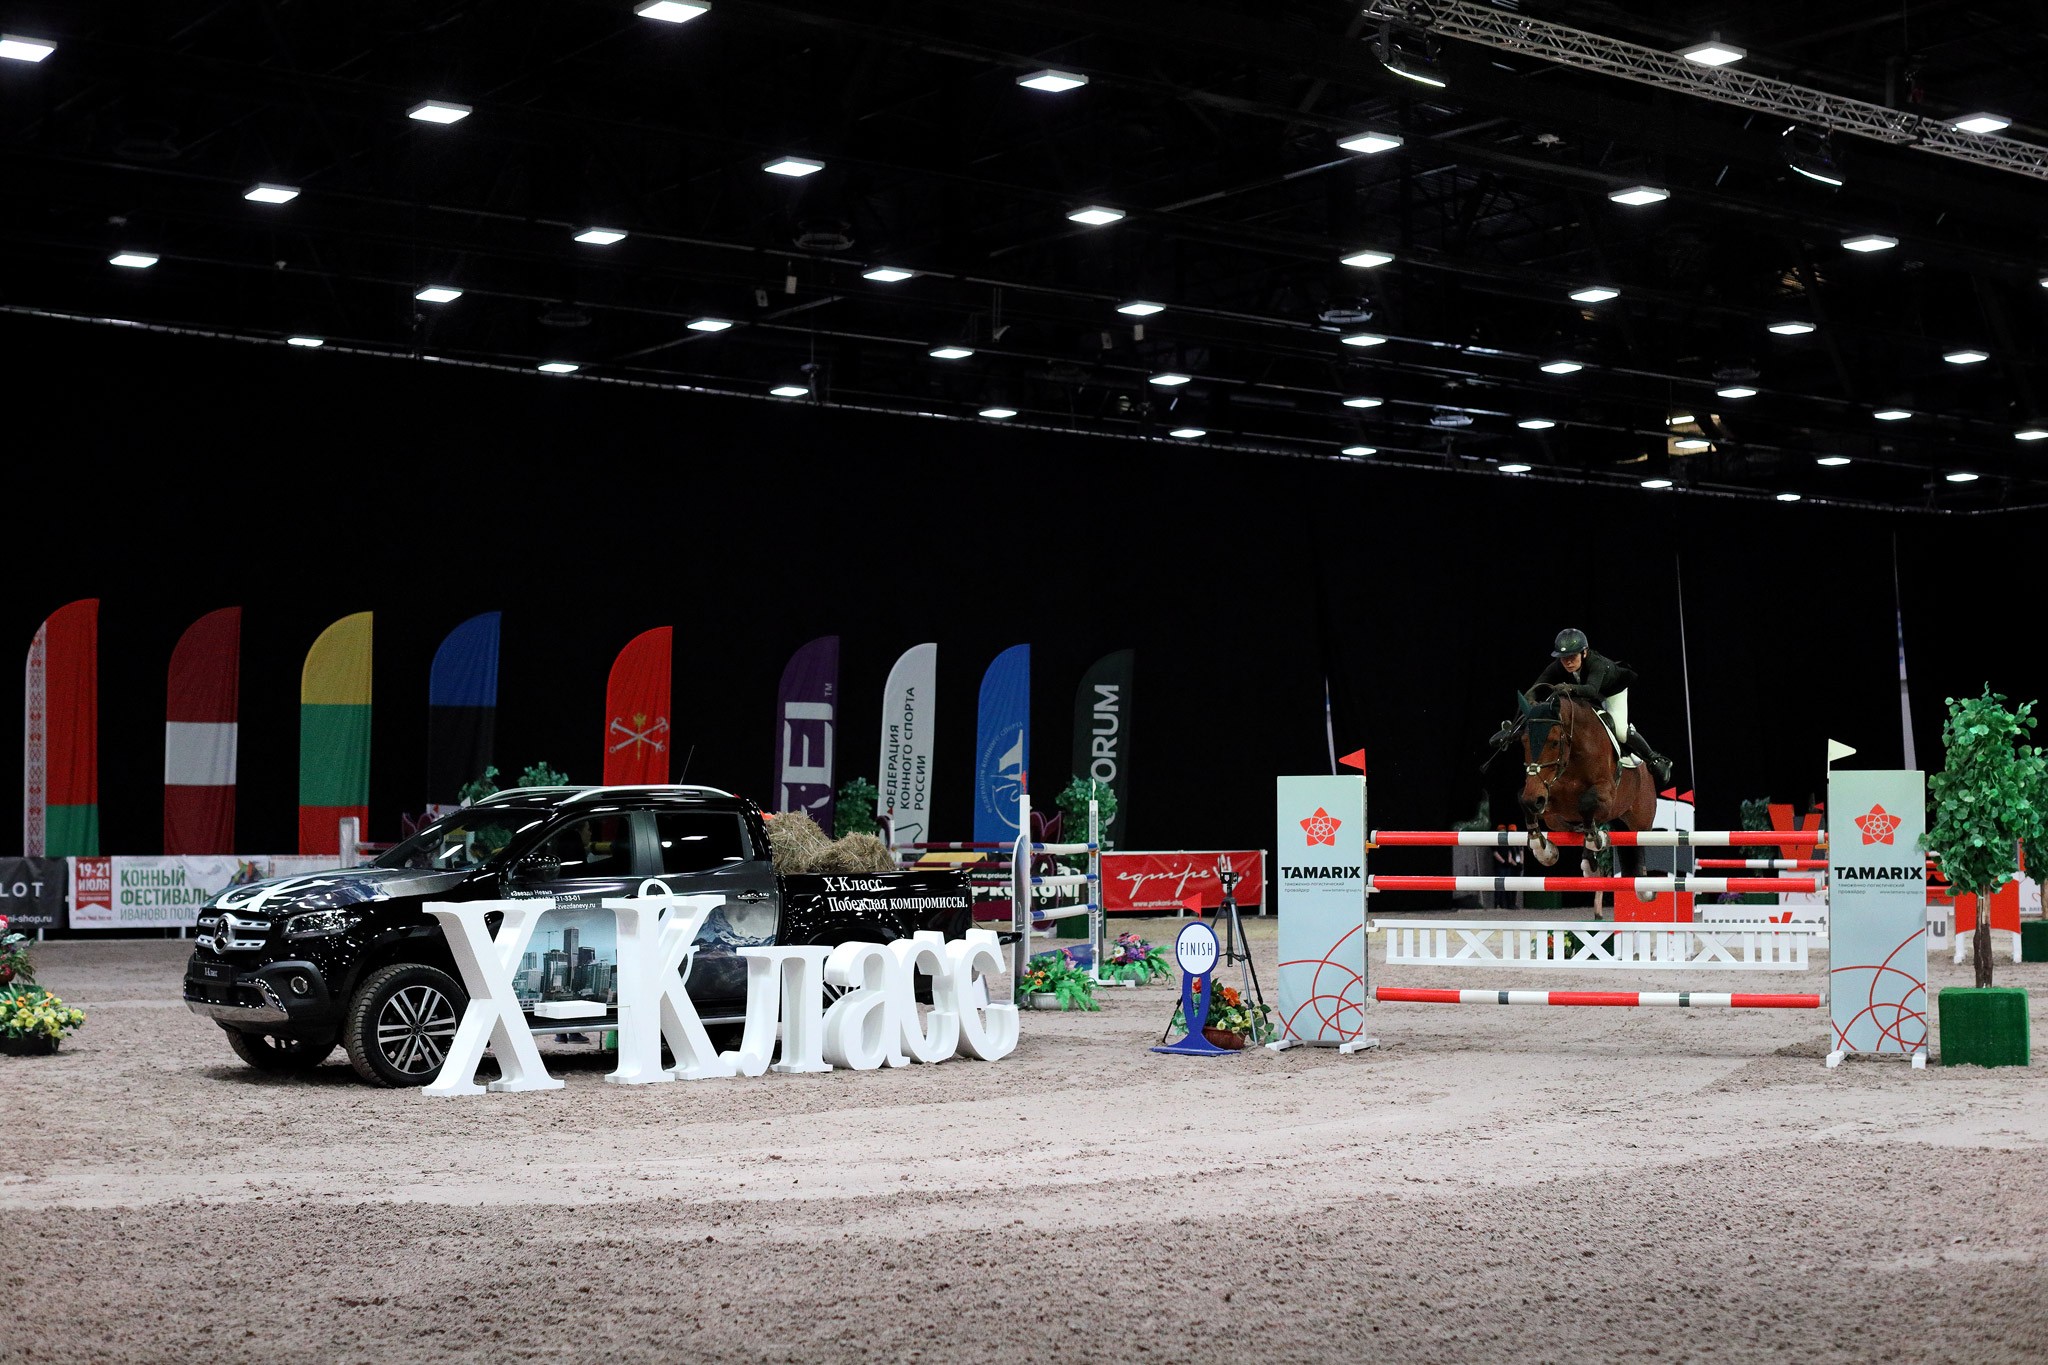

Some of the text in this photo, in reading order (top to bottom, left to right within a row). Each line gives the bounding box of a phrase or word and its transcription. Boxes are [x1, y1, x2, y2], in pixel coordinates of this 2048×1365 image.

[900, 686, 915, 810] КОННОГО СПОРТА
[886, 724, 899, 809] ФЕДЕРАЦИЯ
[914, 755, 926, 811] РОССИИ
[78, 862, 110, 877] 19-21
[120, 864, 186, 887] КОННЫЙ
[1281, 866, 1361, 879] TAMARIX
[1834, 866, 1923, 880] TAMARIX
[78, 878, 110, 892] ИЮЛЯ
[1117, 862, 1211, 900] equipe
[120, 887, 214, 906] ФЕСТИВАЛЬ
[827, 896, 888, 913] Побеждая
[890, 896, 969, 913] компромиссы.
[8, 914, 53, 924] ni-shop.ru
[120, 909, 168, 921] ИВАНОВО
[170, 907, 196, 920] ПОЛЕ
[1179, 942, 1214, 956] FINISH
